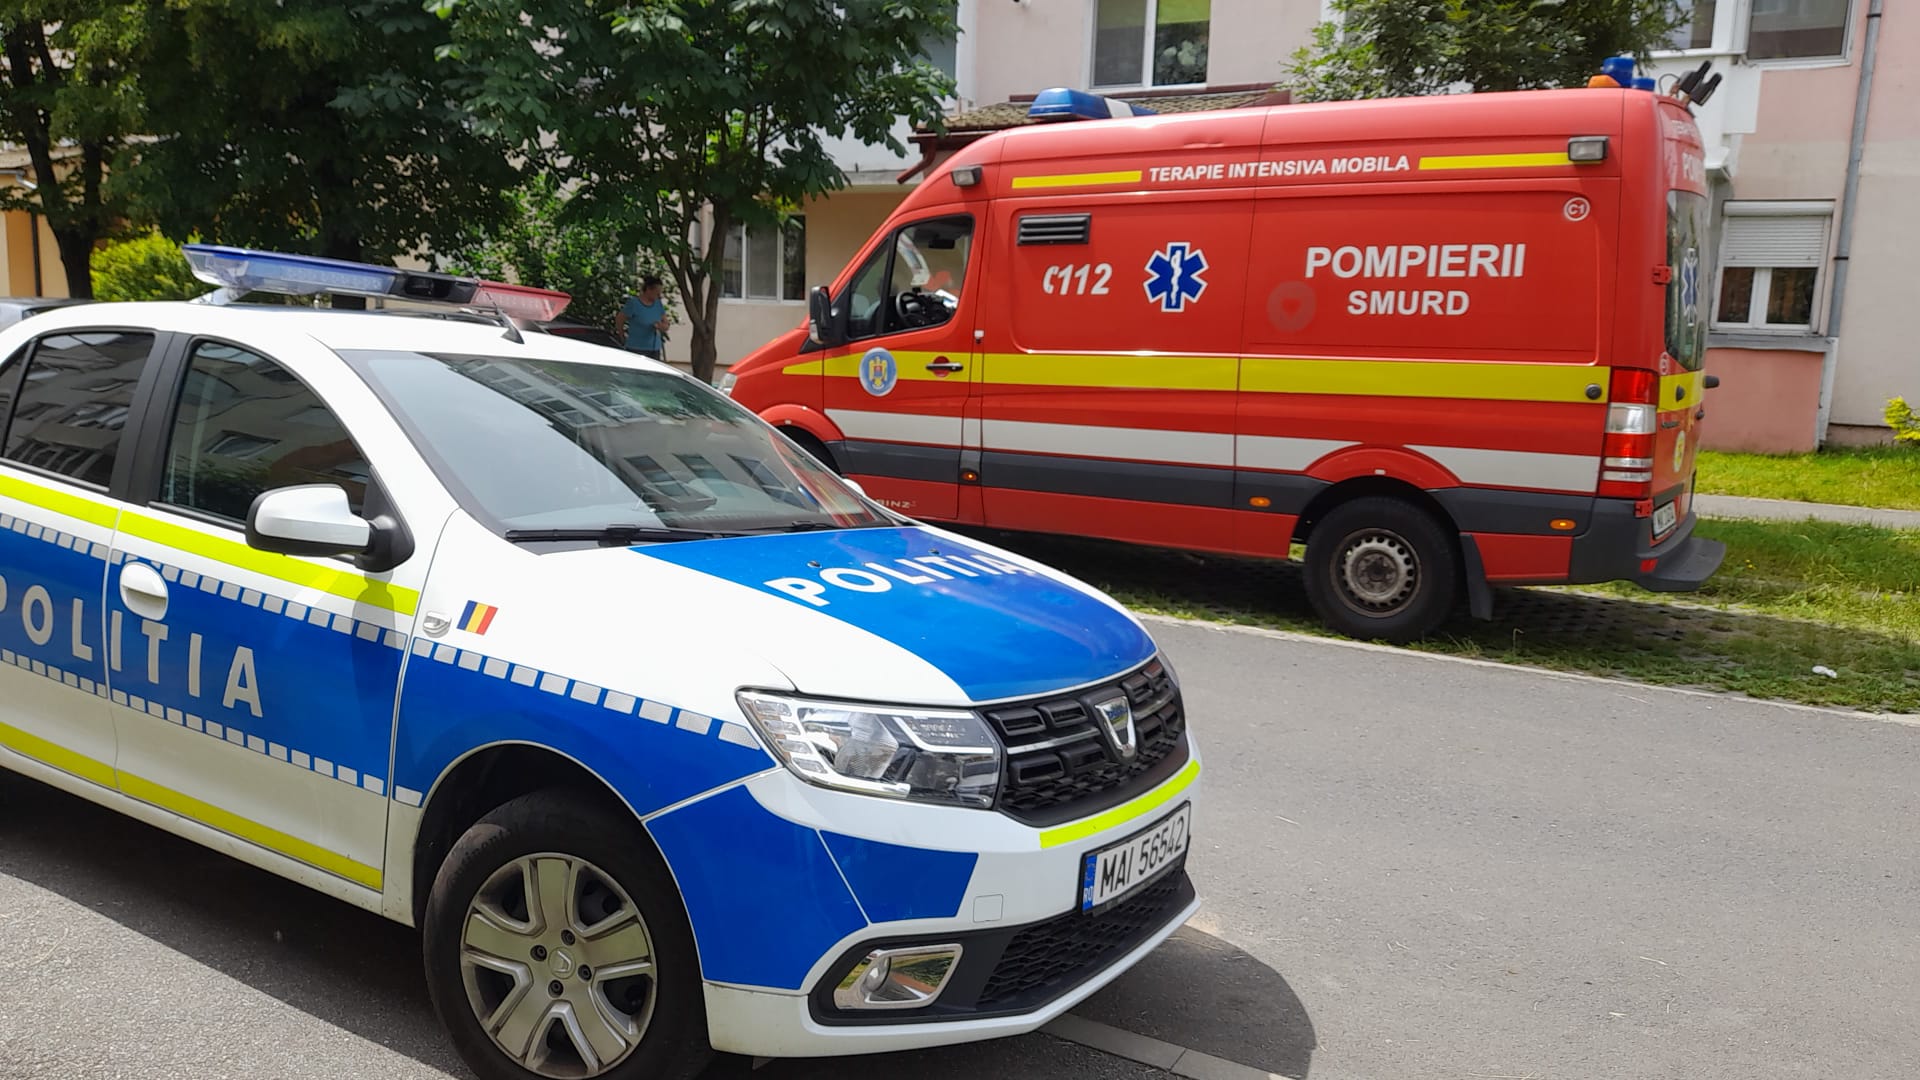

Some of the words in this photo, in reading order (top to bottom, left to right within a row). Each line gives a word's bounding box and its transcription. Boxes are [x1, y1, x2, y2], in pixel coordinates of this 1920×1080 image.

[1149, 164, 1224, 182] TERAPIE
[1228, 159, 1327, 178] INTENSIVA
[1331, 155, 1410, 174] MOBILA
[1567, 203, 1585, 215] C1
[1304, 243, 1526, 279] POMPIERII
[1347, 289, 1470, 316] SMURD
[763, 554, 1037, 607] POLITIA
[0, 574, 264, 718] OLITIA
[1100, 846, 1134, 898] MAI
[1138, 815, 1185, 876] 56542
[1083, 885, 1094, 902] RO
